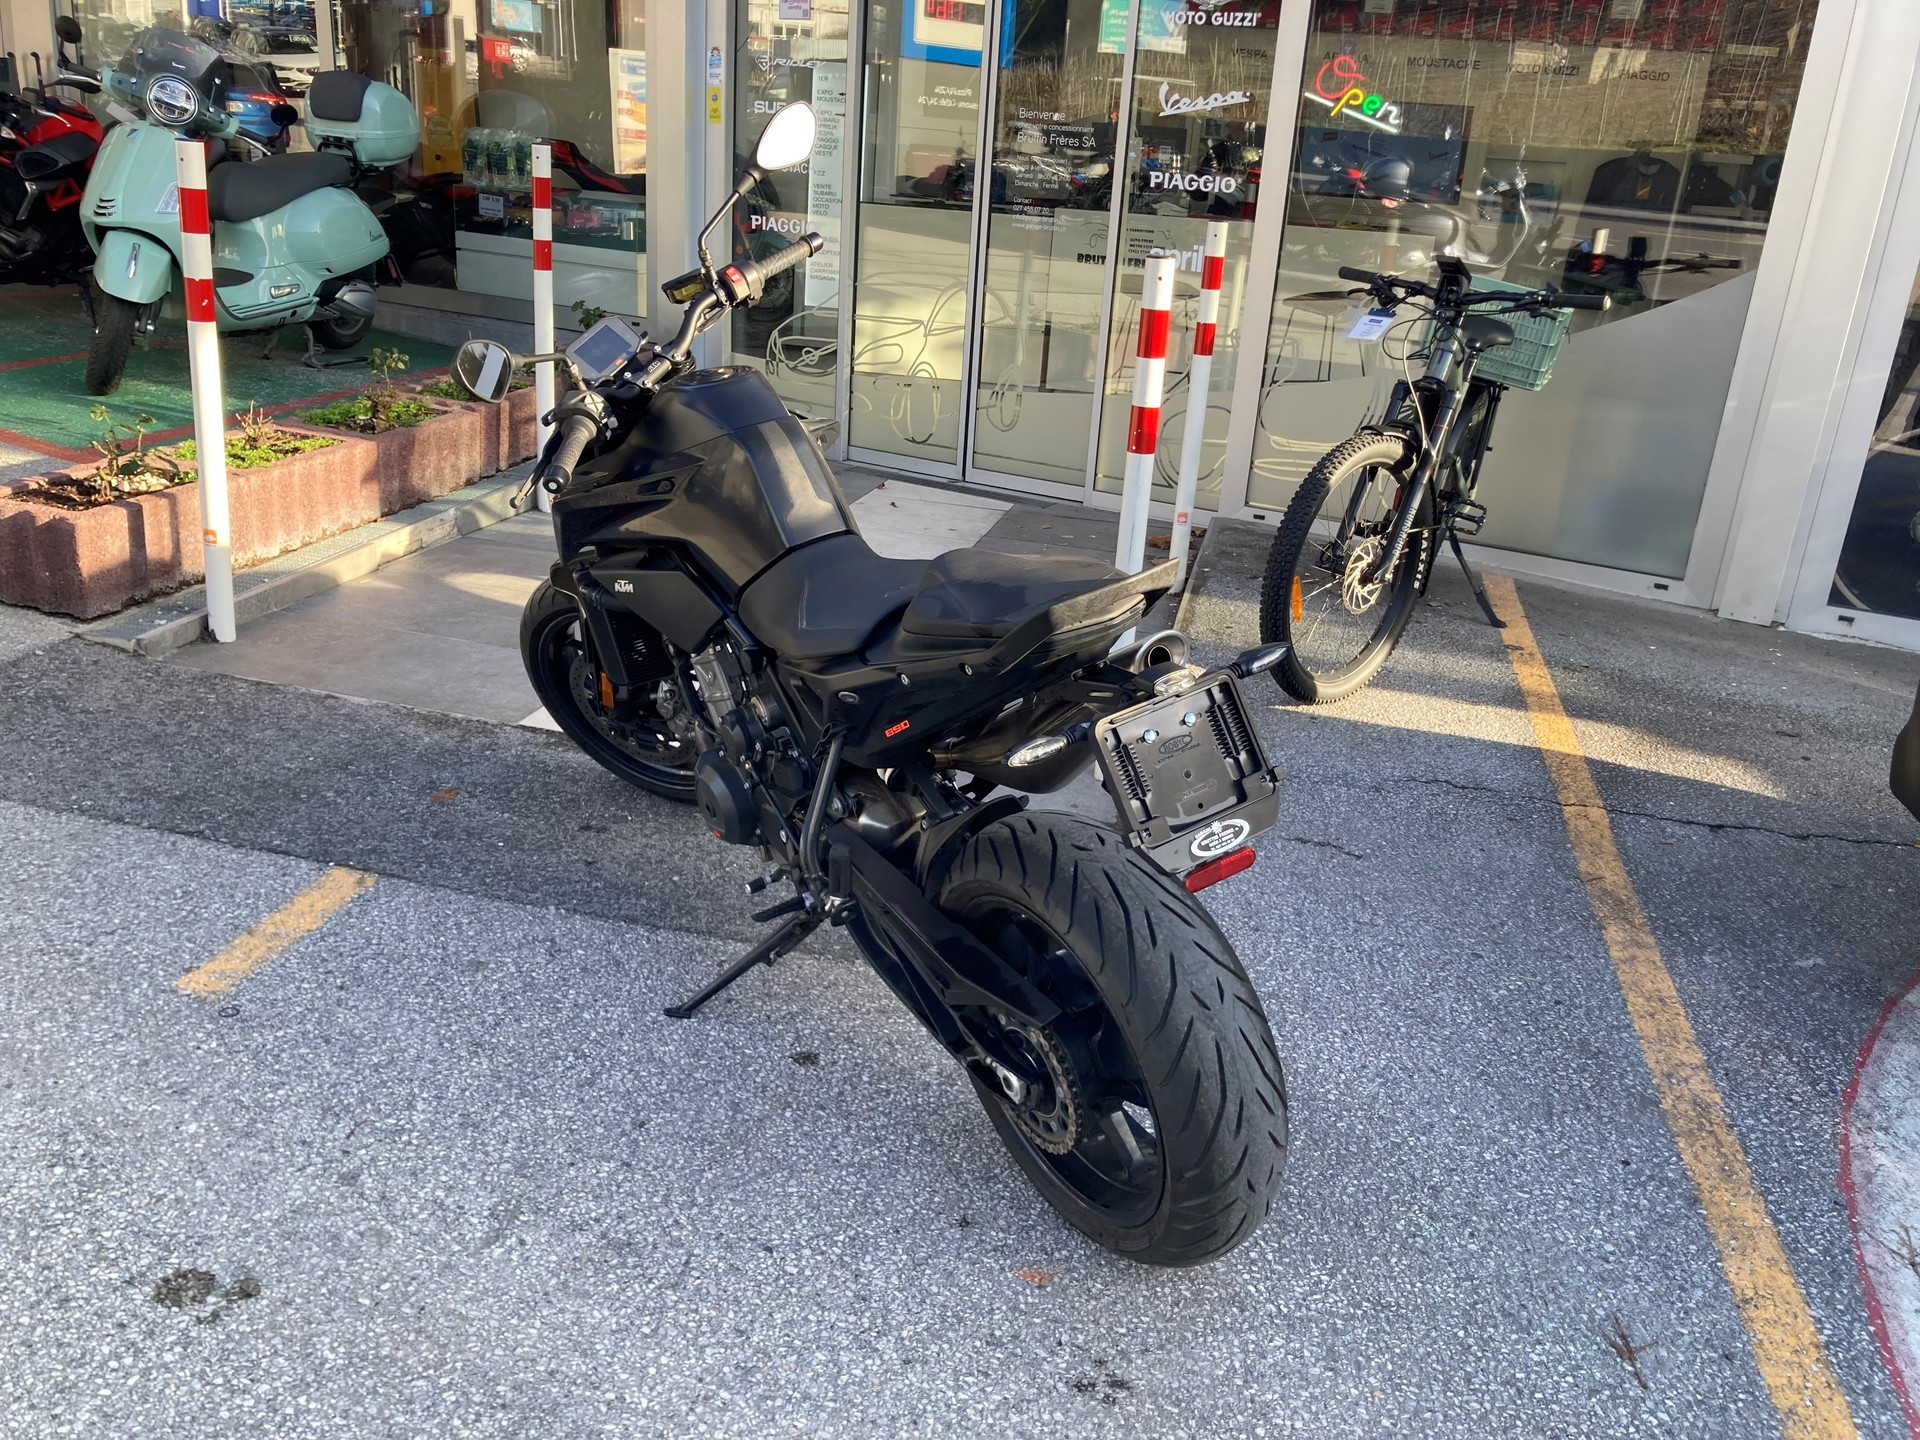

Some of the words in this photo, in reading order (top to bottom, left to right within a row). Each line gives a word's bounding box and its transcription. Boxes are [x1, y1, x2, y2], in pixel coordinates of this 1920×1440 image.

[1165, 12, 1206, 25] MOTO
[1211, 12, 1258, 26] GUZZI
[1232, 48, 1268, 59] VESPA
[773, 58, 826, 68] RIDLEY
[1407, 56, 1480, 70] MOUSTACHE
[1544, 66, 1580, 76] GUZZI
[1619, 70, 1670, 82] PIAGGIO
[1314, 55, 1400, 124] Open
[816, 96, 846, 104] MOUSTAC
[1159, 81, 1250, 117] Vespa
[1019, 108, 1066, 120] Bienvenue
[1048, 124, 1094, 133] concessionnaire
[1050, 134, 1079, 146] Frères
[1082, 136, 1096, 148] SA
[1150, 171, 1236, 193] PIAGGIO
[1413, 530, 1428, 589] MAXXIS
[615, 580, 634, 593] KTM
[884, 720, 910, 737] 890
